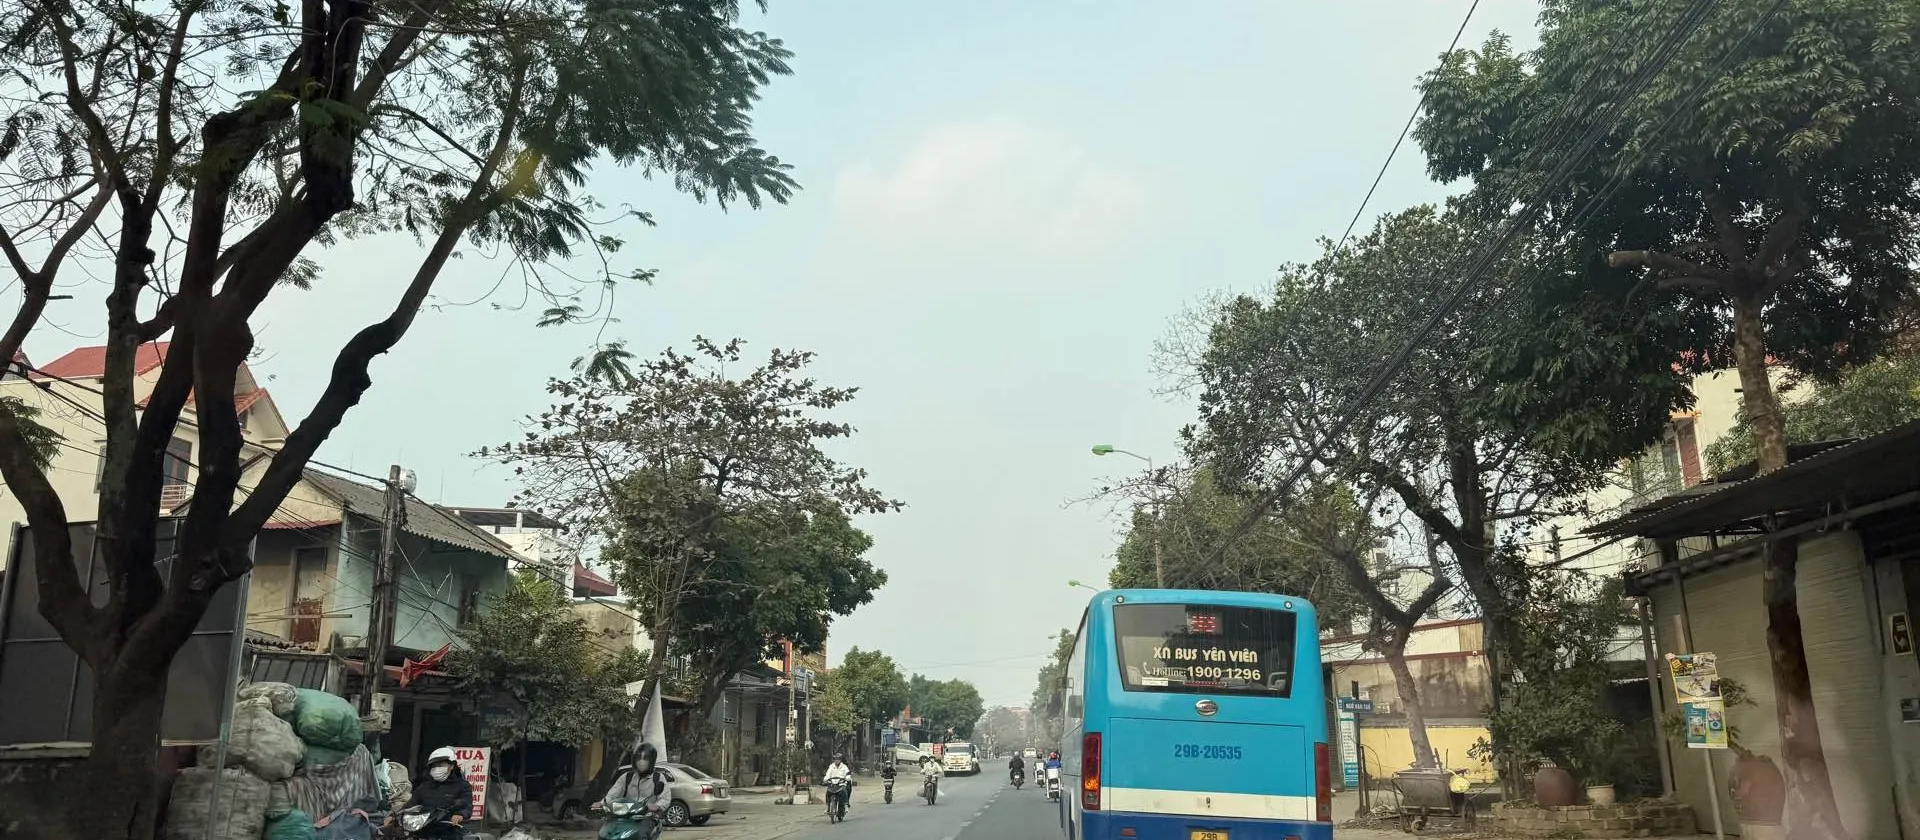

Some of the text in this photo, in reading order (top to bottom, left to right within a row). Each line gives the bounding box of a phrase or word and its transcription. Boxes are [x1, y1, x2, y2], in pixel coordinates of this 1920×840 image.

[1175, 647, 1198, 661] BUS
[1202, 646, 1227, 662] YÊN
[1229, 648, 1258, 663] VIÊN
[1187, 666, 1222, 678] 1900
[1226, 667, 1262, 680] 1296
